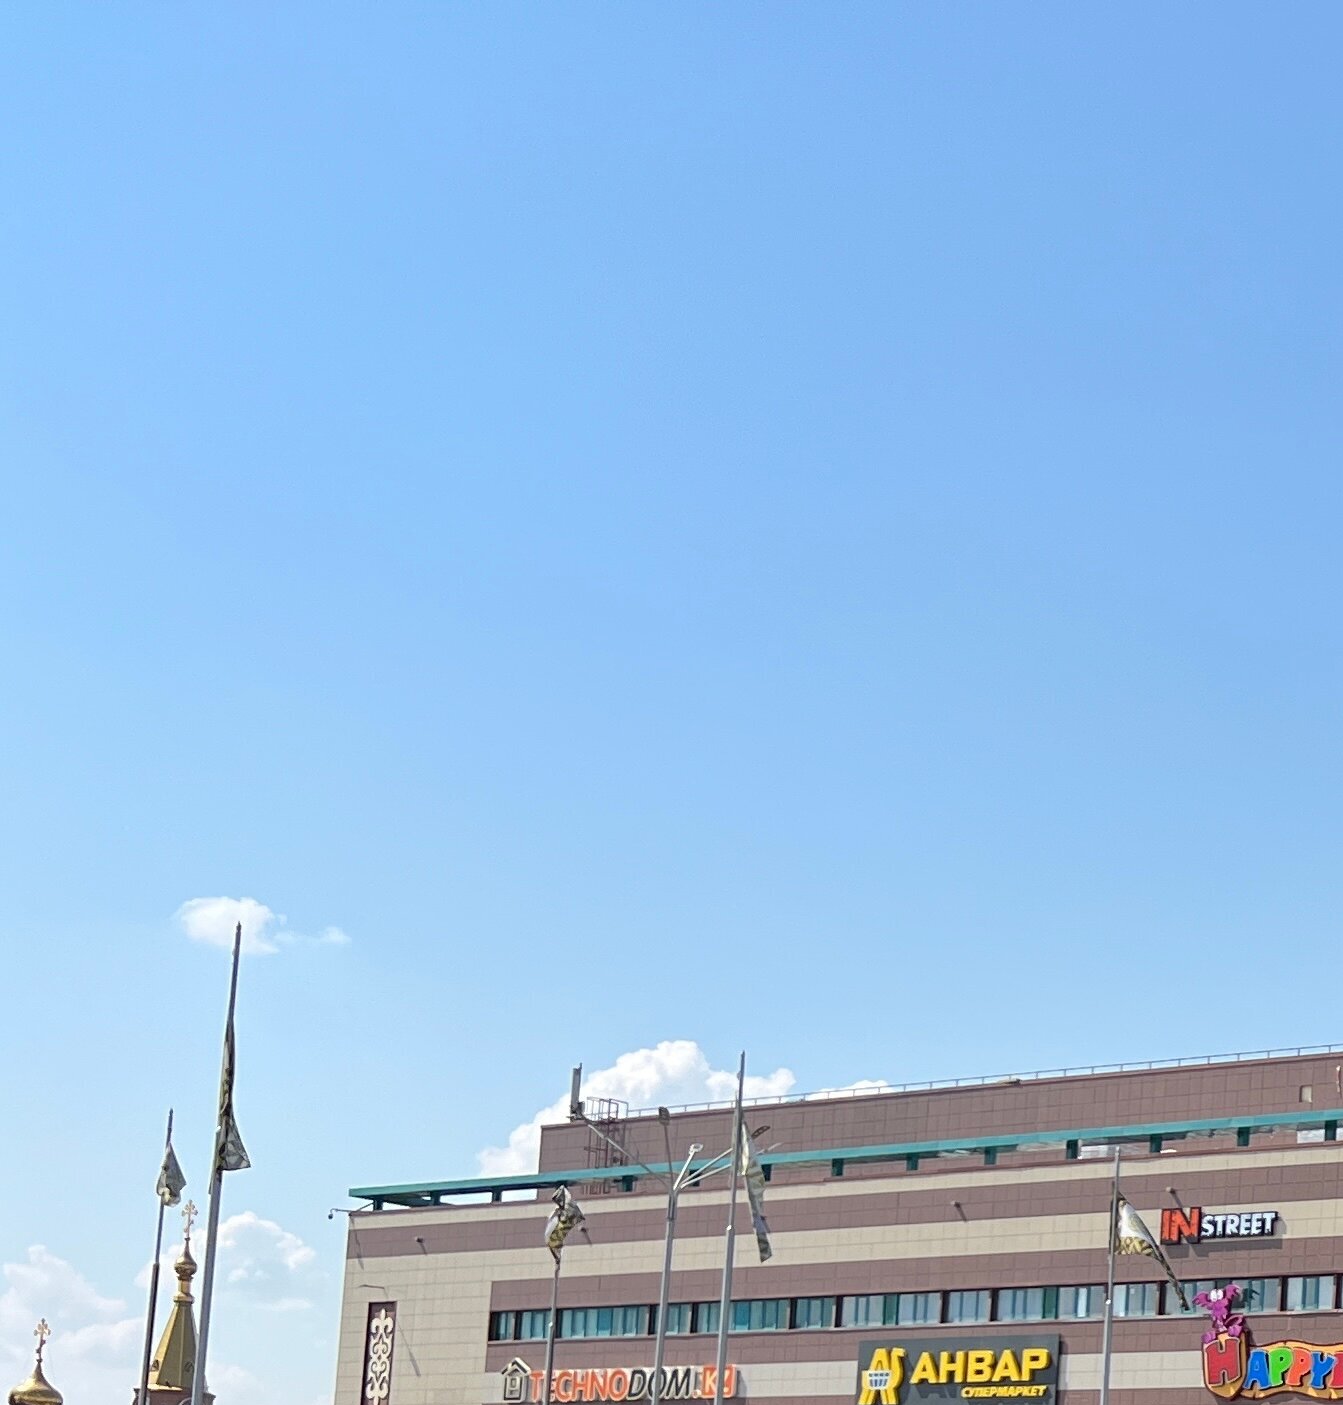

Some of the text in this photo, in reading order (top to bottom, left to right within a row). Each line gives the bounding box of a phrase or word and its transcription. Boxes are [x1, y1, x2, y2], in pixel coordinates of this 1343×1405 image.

[1160, 1206, 1278, 1244] IN STREET
[910, 1348, 1050, 1385] АНВАР
[960, 1385, 1048, 1398] СУПЕРМАРКЕТ
